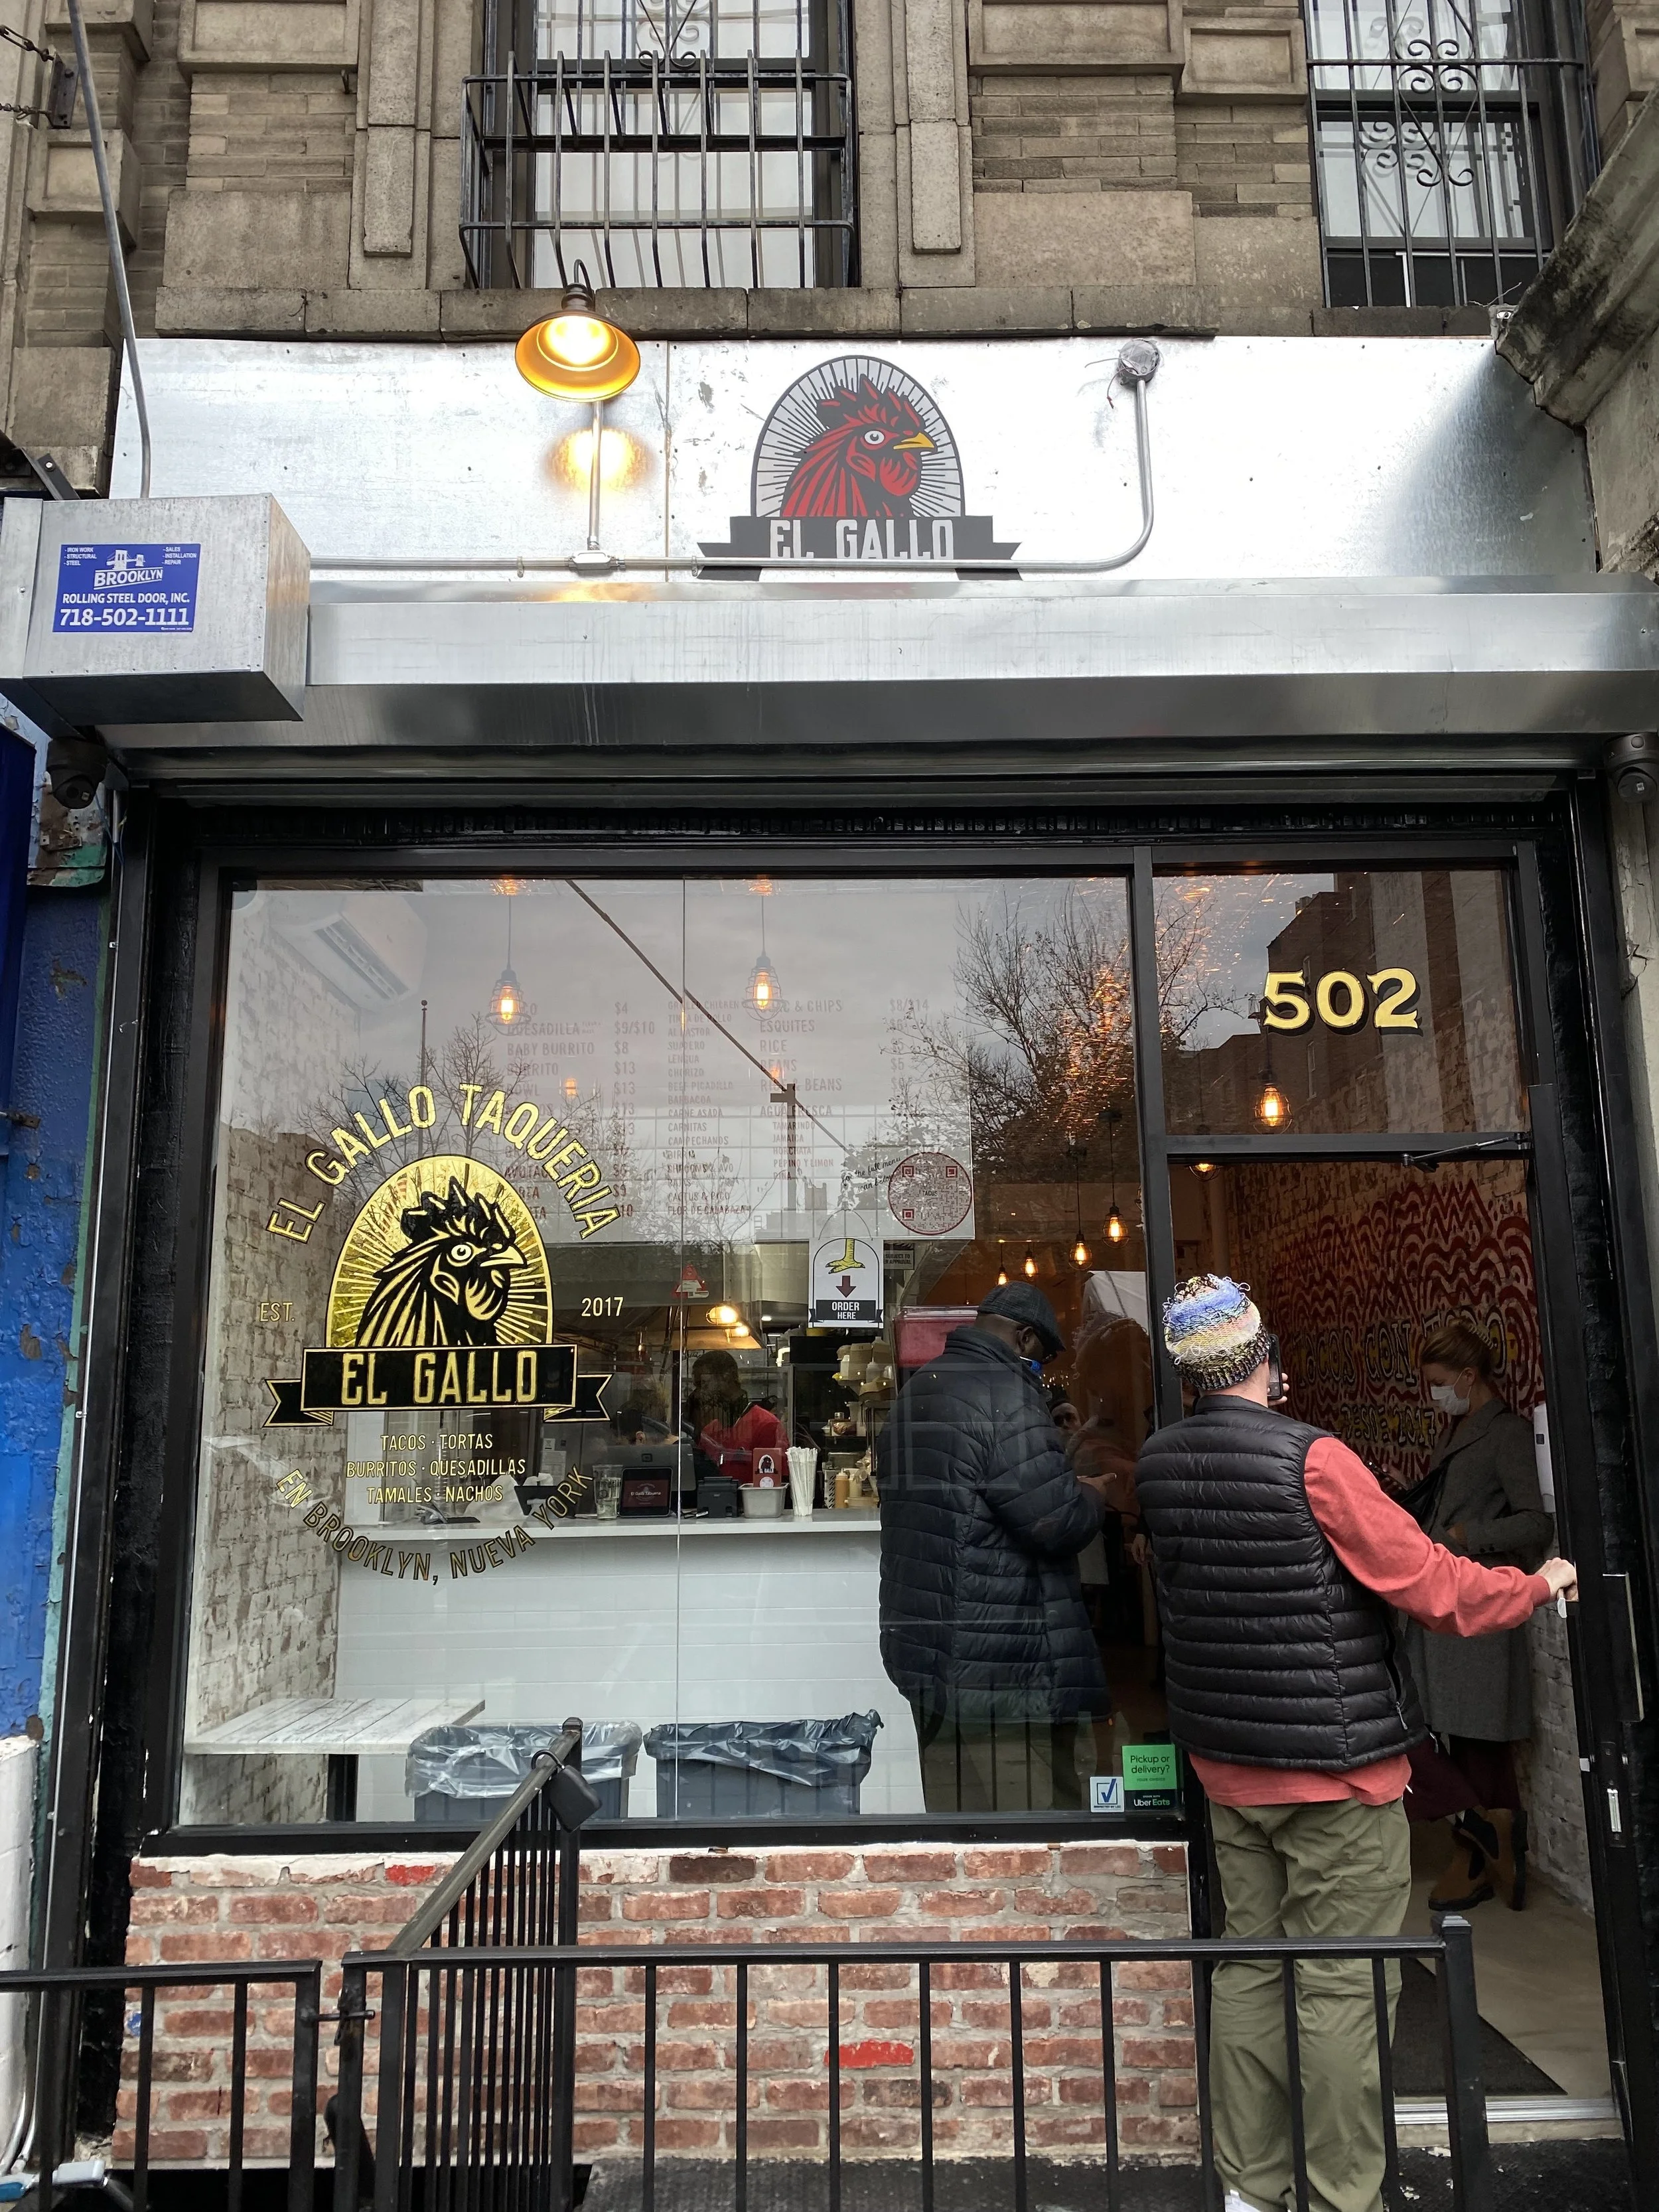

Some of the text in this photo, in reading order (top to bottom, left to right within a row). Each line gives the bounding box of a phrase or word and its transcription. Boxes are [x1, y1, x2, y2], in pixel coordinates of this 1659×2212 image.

[770, 519, 954, 559] EL GALLO
[94, 569, 163, 587] BROOKLYN
[62, 593, 190, 605] ROLLING STEEL DOOR, INC.
[60, 608, 189, 626] 718-502-1111
[704, 999, 739, 1009] CHICKEN
[807, 999, 843, 1013] CHIPS
[1263, 968, 1421, 1033] 502
[614, 1001, 629, 1017] $4
[668, 1014, 692, 1023] TINA
[760, 1019, 816, 1033] ESQUITES
[508, 1041, 630, 1056] BABY BURRITO $8
[760, 1039, 788, 1053] RICE
[614, 1061, 636, 1075] $13
[805, 1078, 842, 1092] BEANS
[697, 1108, 723, 1118] ASADA
[668, 1122, 707, 1132] CARNITAS
[772, 1122, 815, 1131] TAMARINDO
[265, 1082, 620, 1244] EL GALLO TAQUERIA
[882, 1157, 901, 1169] menu
[259, 1301, 296, 1322] EST.
[581, 1297, 624, 1317] 2017
[831, 1302, 860, 1320] ORDER HERE
[341, 1351, 538, 1404] EL GALLO
[380, 1433, 494, 1451] TACOS TORTAS
[346, 1460, 416, 1478] BURRITOS
[429, 1459, 526, 1477] QUESADILLAS
[366, 1485, 503, 1504] TAMALES NACHOS
[275, 1464, 595, 1585] EN BROOKLYN, NUEVA YORK
[1130, 1755, 1159, 1764] Pickup
[1131, 1765, 1170, 1775] delivery?
